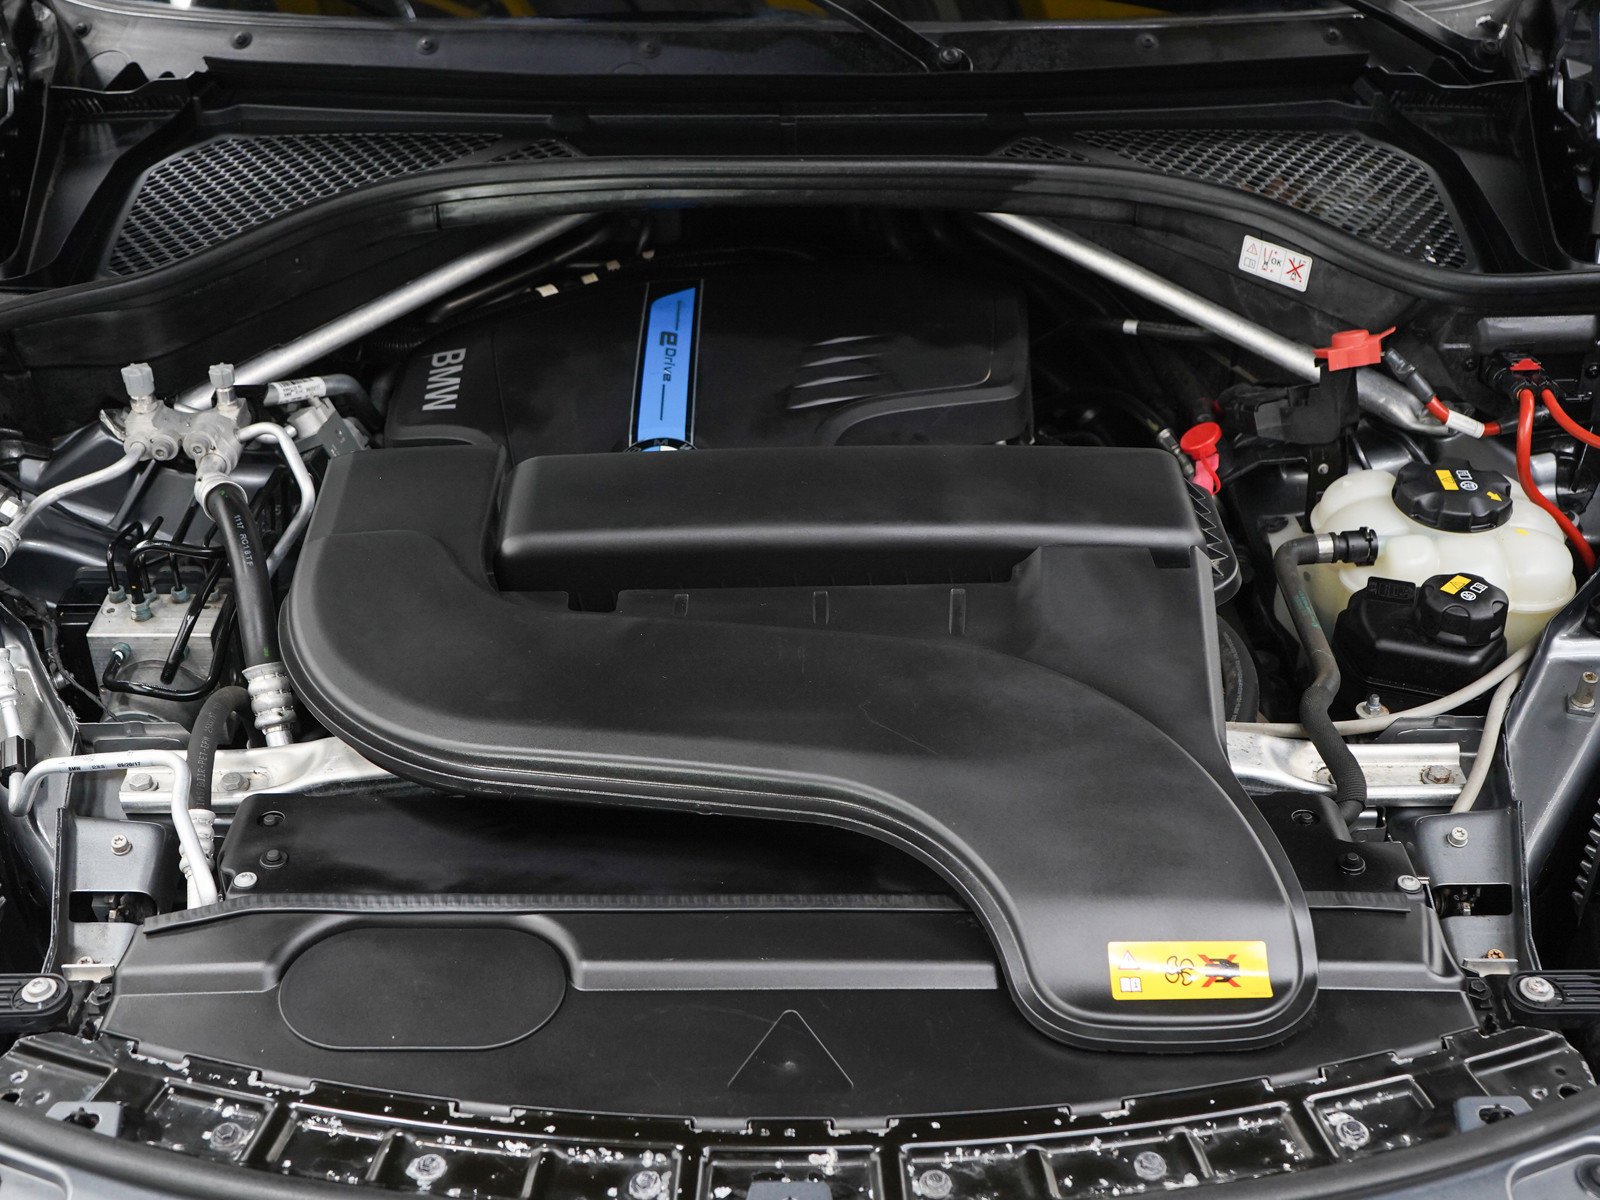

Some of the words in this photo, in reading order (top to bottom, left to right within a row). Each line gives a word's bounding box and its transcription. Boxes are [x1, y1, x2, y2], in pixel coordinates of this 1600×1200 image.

[1271, 258, 1281, 267] OK
[422, 347, 467, 411] BMW
[660, 331, 678, 382] eDrive
